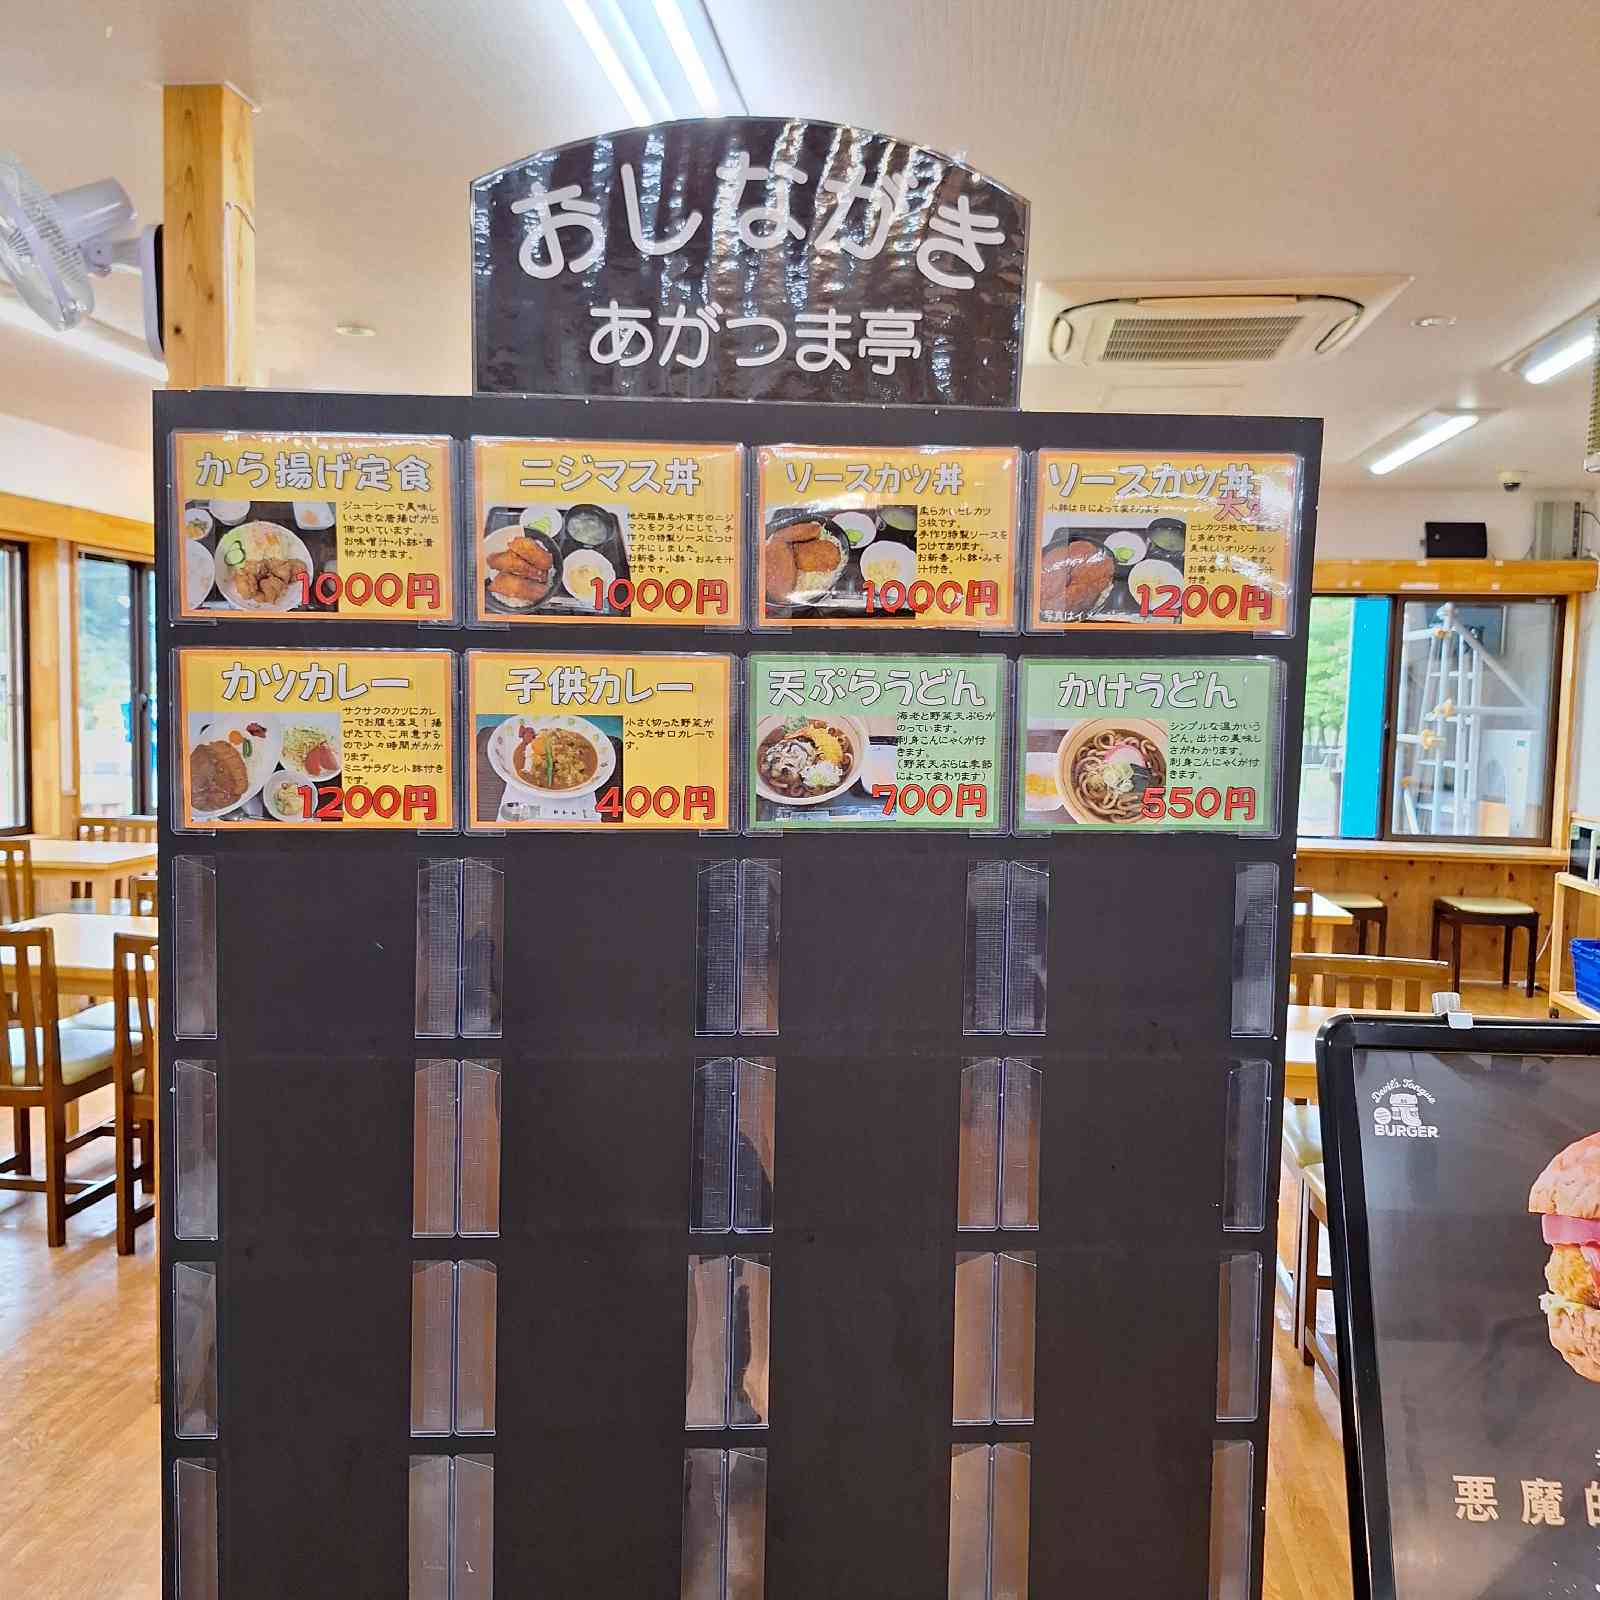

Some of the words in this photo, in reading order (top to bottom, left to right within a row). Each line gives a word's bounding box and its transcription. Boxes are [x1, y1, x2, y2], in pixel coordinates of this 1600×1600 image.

[511, 152, 1006, 290] おしながき
[589, 301, 922, 376] あがつま亭
[196, 451, 432, 492] から揚げ定食
[520, 454, 701, 496] ニジマス丼
[785, 462, 964, 495] ソースカツ丼
[1049, 462, 1254, 498] ソースカツ丼
[295, 572, 440, 609] 1000円
[591, 577, 728, 615] 1000円
[863, 579, 999, 616] 1000円
[1136, 584, 1272, 620] 1200円
[221, 662, 409, 702] カツカレー
[505, 666, 693, 705] 子供カレー
[768, 668, 985, 706] 天ぷらうどん
[1058, 670, 1237, 708] かけうどん
[625, 717, 714, 728] 小さく切った野菜が
[625, 729, 715, 739] 入った甘口カレーで
[297, 785, 437, 821] 1200円
[595, 785, 715, 820] 400円
[871, 783, 987, 818] 700円
[1140, 786, 1256, 821] 550円
[1402, 1078, 1437, 1105] Tongue
[1374, 1124, 1439, 1138] BURGER
